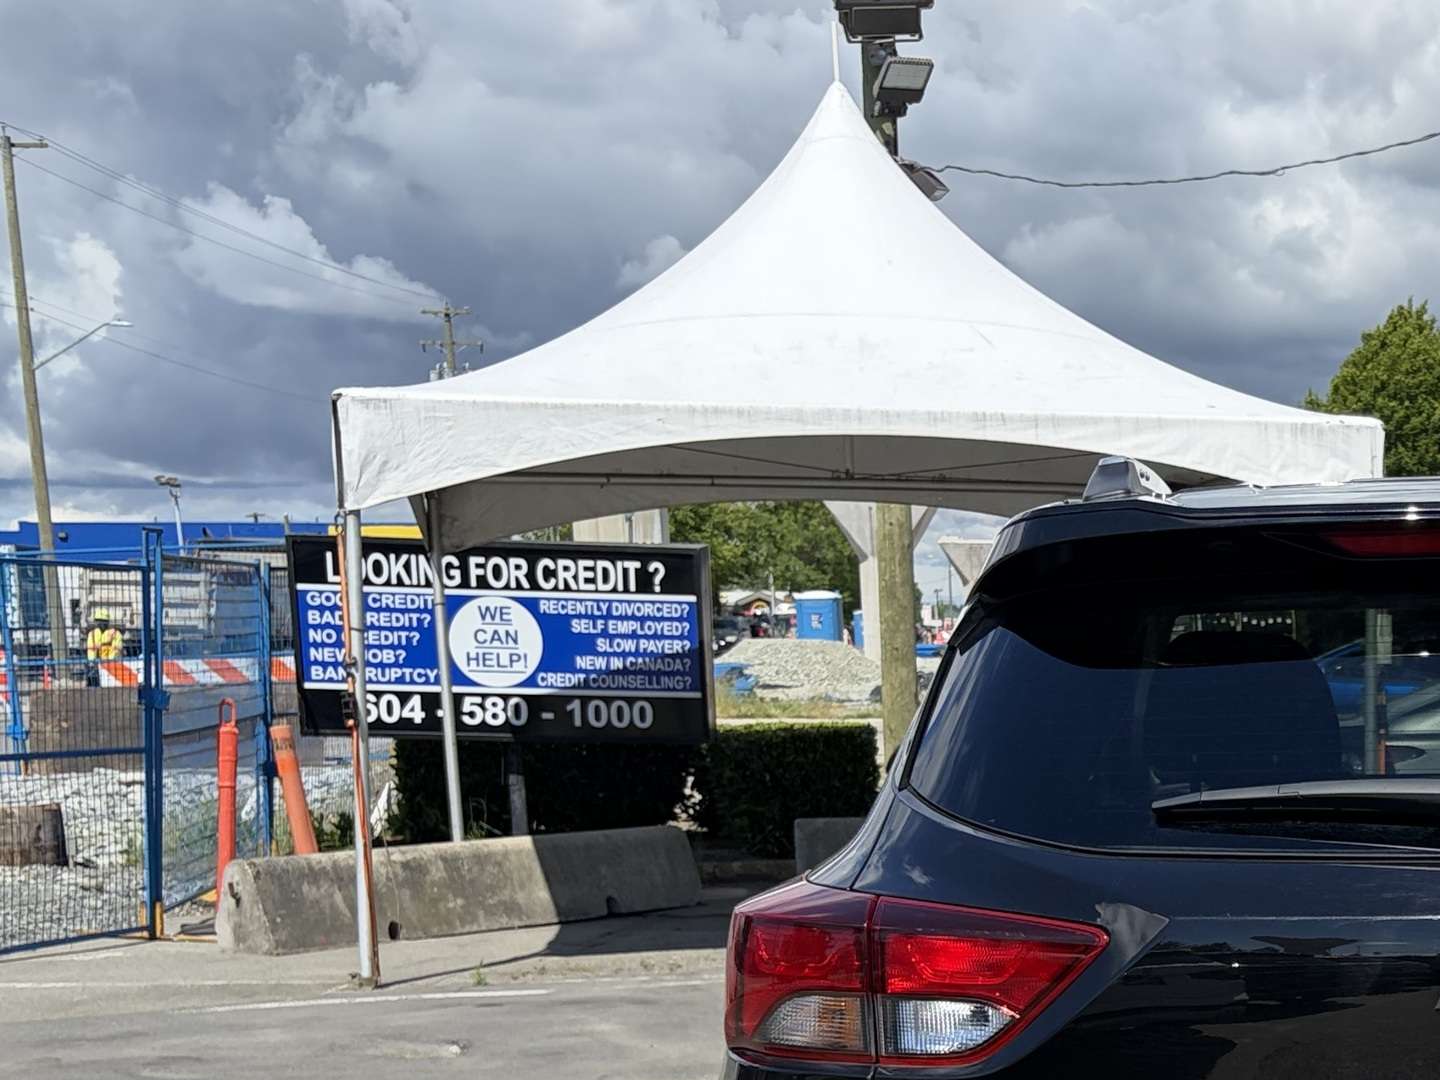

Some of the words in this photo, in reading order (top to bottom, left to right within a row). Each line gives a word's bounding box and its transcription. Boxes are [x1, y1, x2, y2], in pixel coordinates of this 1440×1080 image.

[326, 551, 462, 588] LOKING
[469, 555, 531, 589] FOR
[537, 557, 642, 592] CREDIT
[647, 561, 666, 593] ?
[478, 605, 513, 622] WE
[539, 600, 610, 616] RECENTLY
[612, 602, 690, 618] DIVORCED?
[366, 611, 432, 628] REDIT?
[571, 618, 605, 634] SELF
[608, 620, 690, 636] EMPLOYED?
[308, 628, 338, 643] NO
[474, 629, 519, 645] CAN
[596, 638, 637, 653] SLOW
[639, 640, 691, 654] PAYER?
[466, 652, 528, 669] HELP!
[576, 656, 607, 670] NEW
[611, 657, 624, 671] IN
[626, 657, 692, 672] CANADA?
[537, 673, 586, 688] CREDIT
[589, 674, 692, 690] COUNSELLING?
[460, 696, 529, 727] 580
[566, 698, 654, 729] 1000
